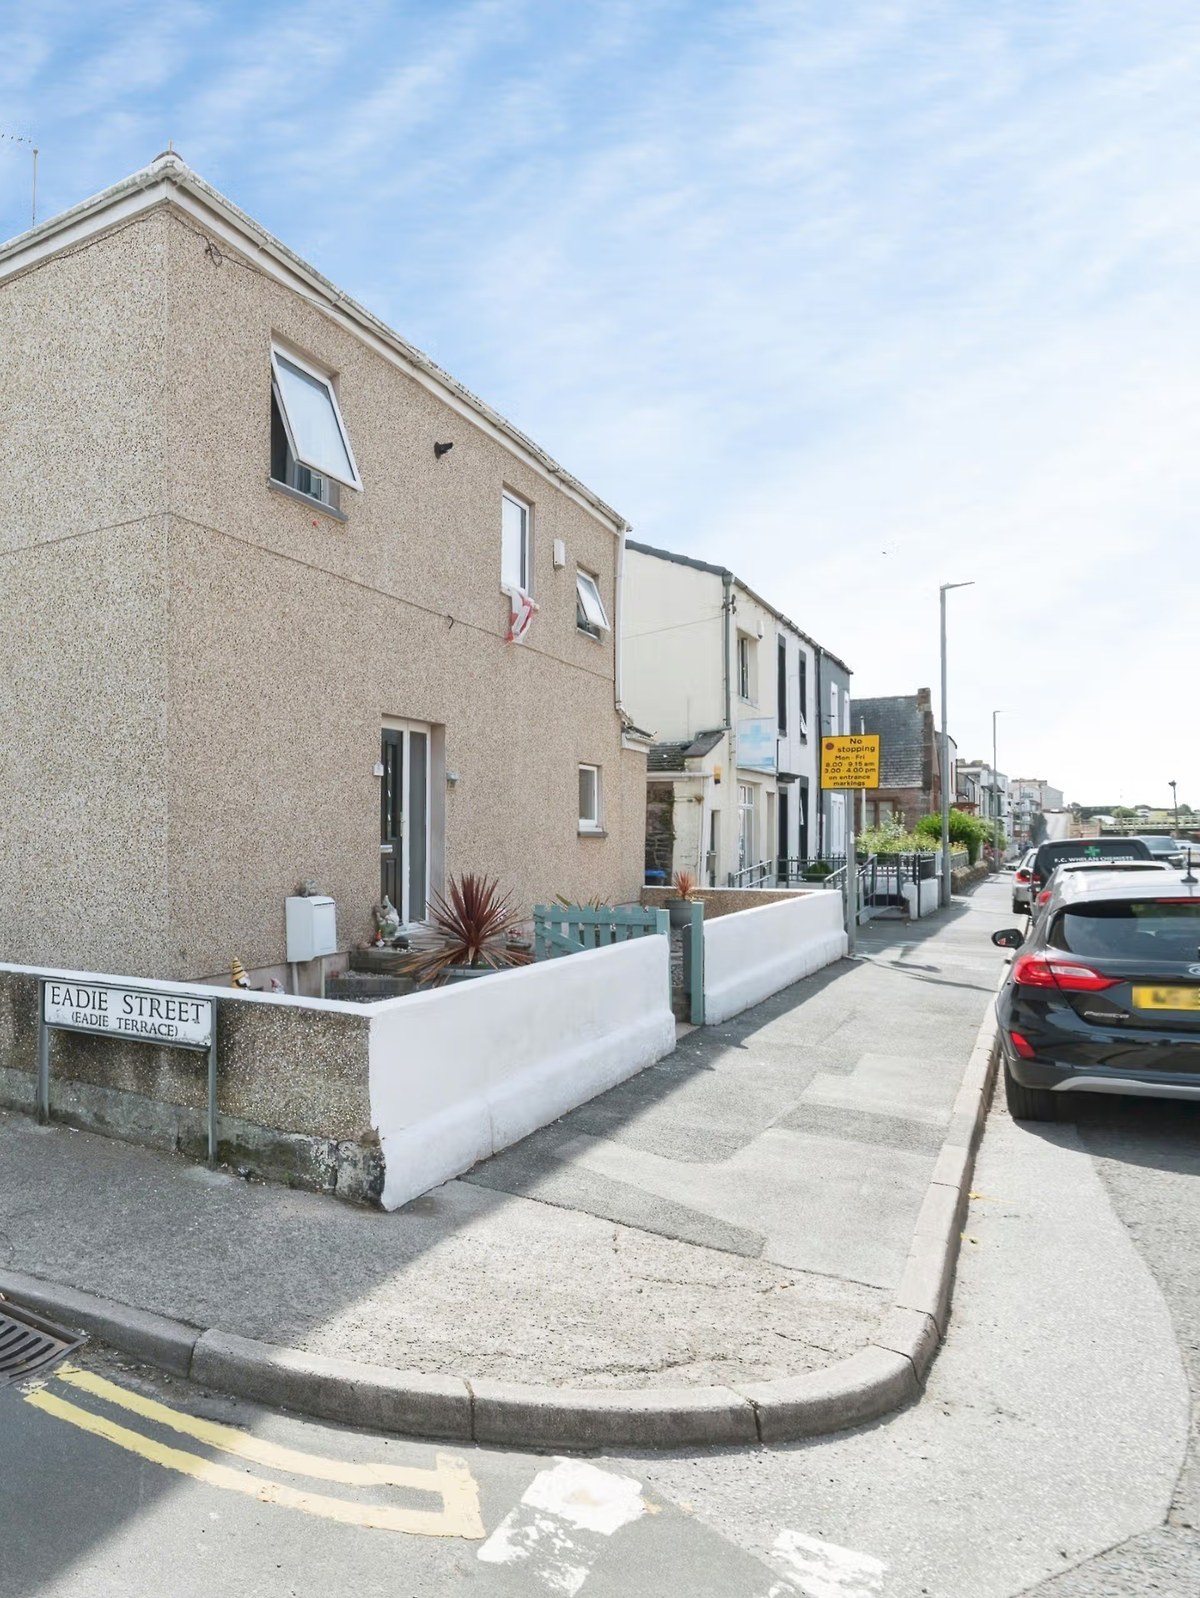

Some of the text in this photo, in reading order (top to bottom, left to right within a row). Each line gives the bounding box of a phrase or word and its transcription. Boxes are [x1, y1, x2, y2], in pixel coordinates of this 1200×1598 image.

[51, 986, 205, 1024] EADIE STREET
[71, 1012, 178, 1038] (EADIE TERRACE)
